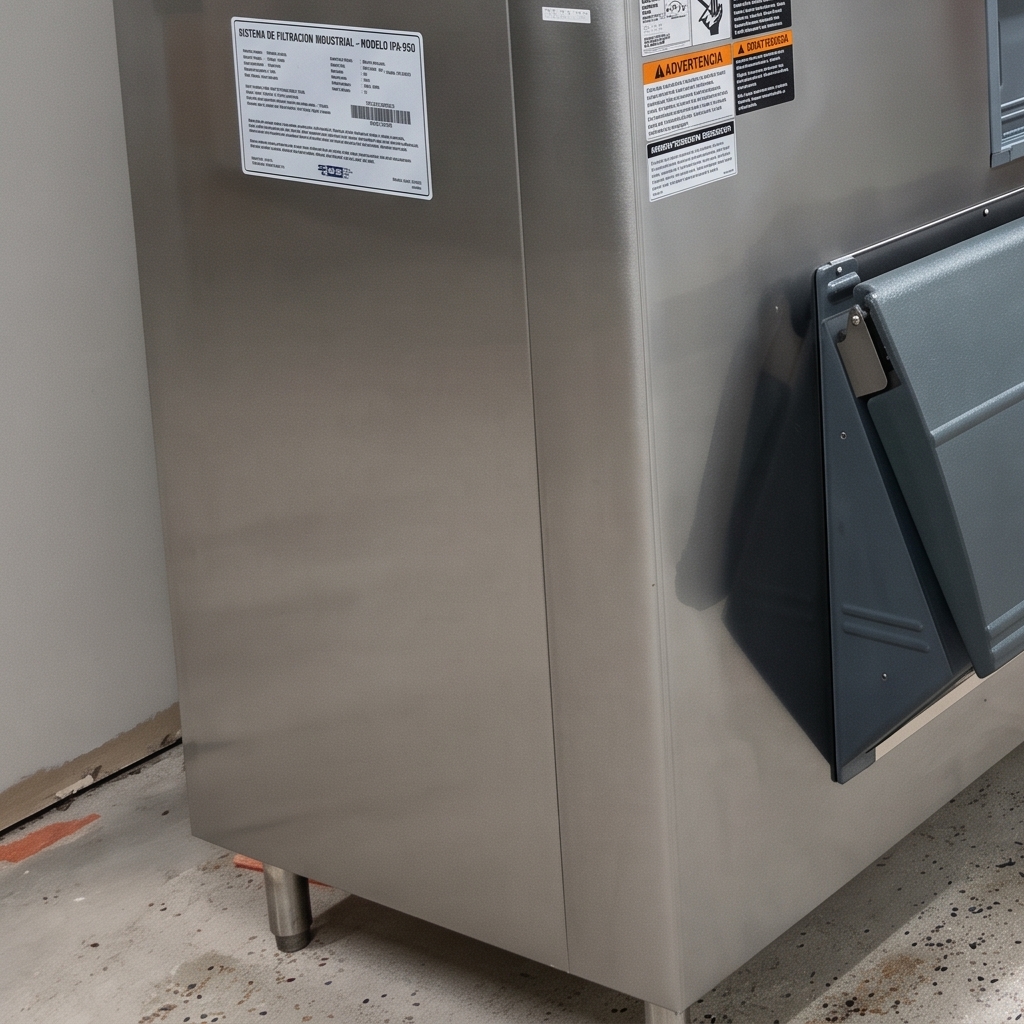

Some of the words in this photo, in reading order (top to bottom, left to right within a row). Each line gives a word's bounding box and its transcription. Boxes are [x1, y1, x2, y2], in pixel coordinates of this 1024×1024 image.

[238, 28, 265, 39] SISTEMA
[266, 30, 276, 41] DE
[665, 51, 723, 76] ADVERTENCIA
